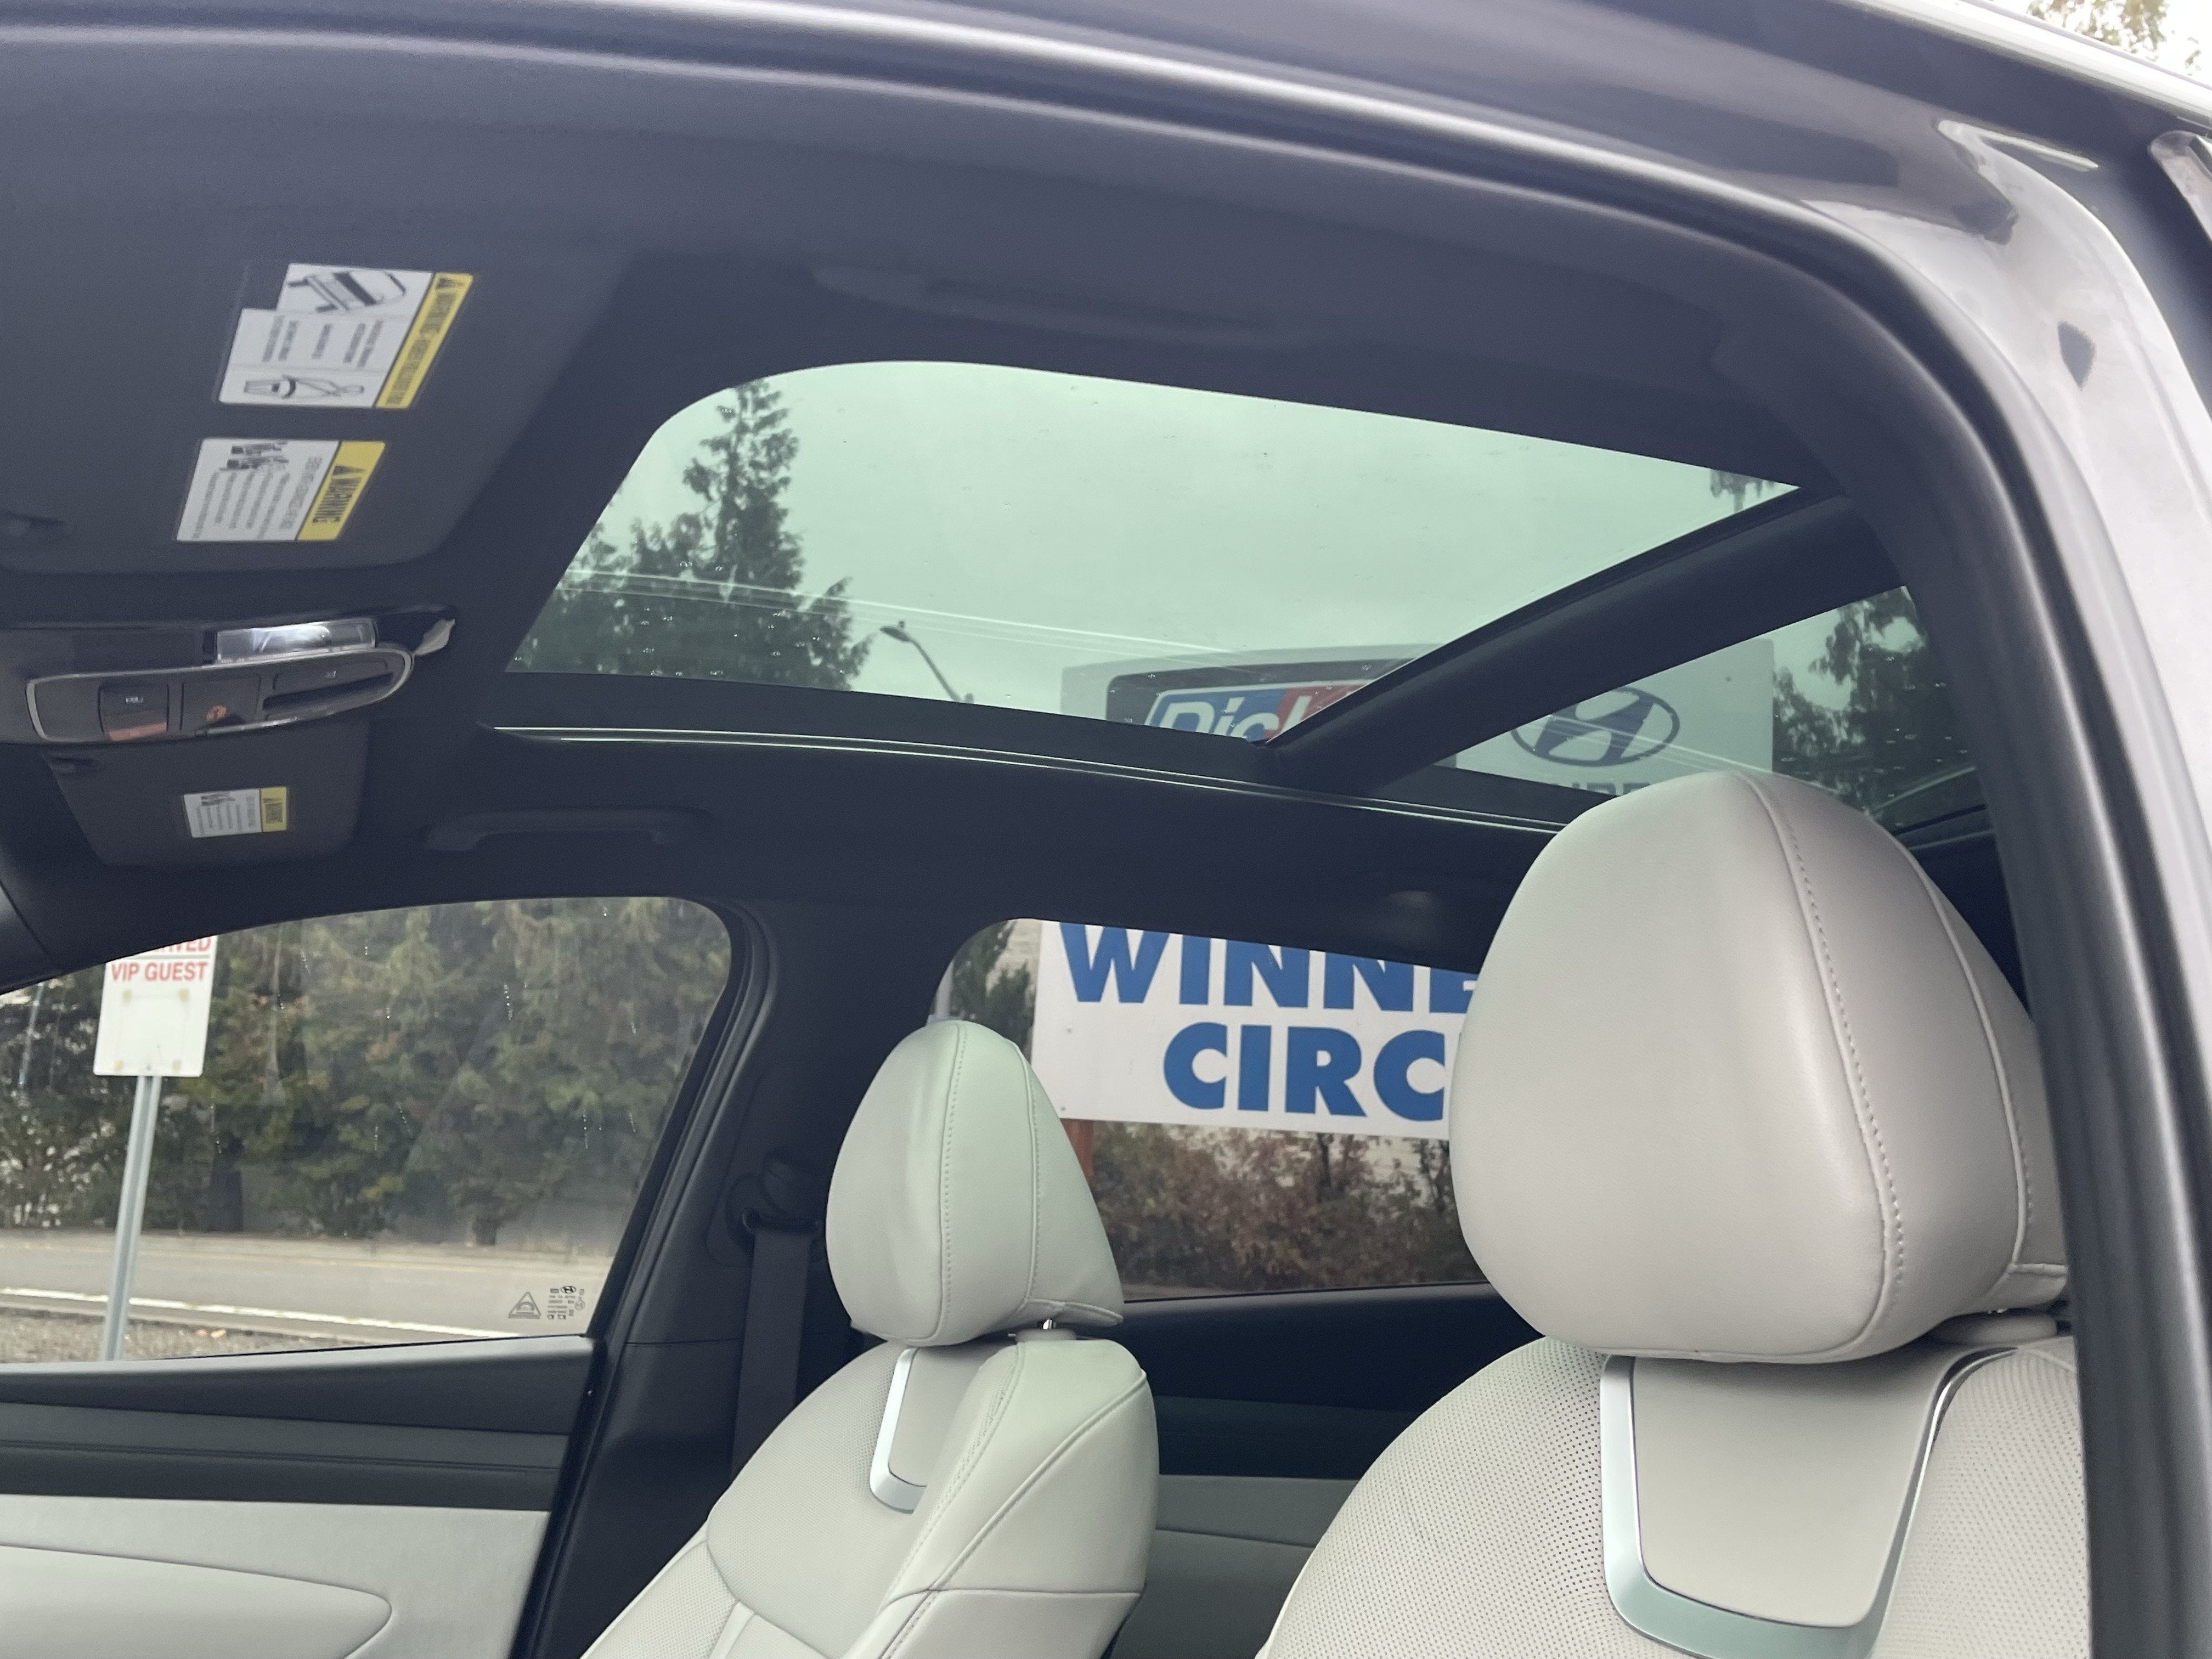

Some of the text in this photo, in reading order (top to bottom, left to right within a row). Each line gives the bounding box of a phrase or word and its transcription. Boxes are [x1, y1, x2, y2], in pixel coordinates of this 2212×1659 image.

[111, 961, 208, 981] VIP GUEST
[1163, 1022, 1446, 1122] CIRC
